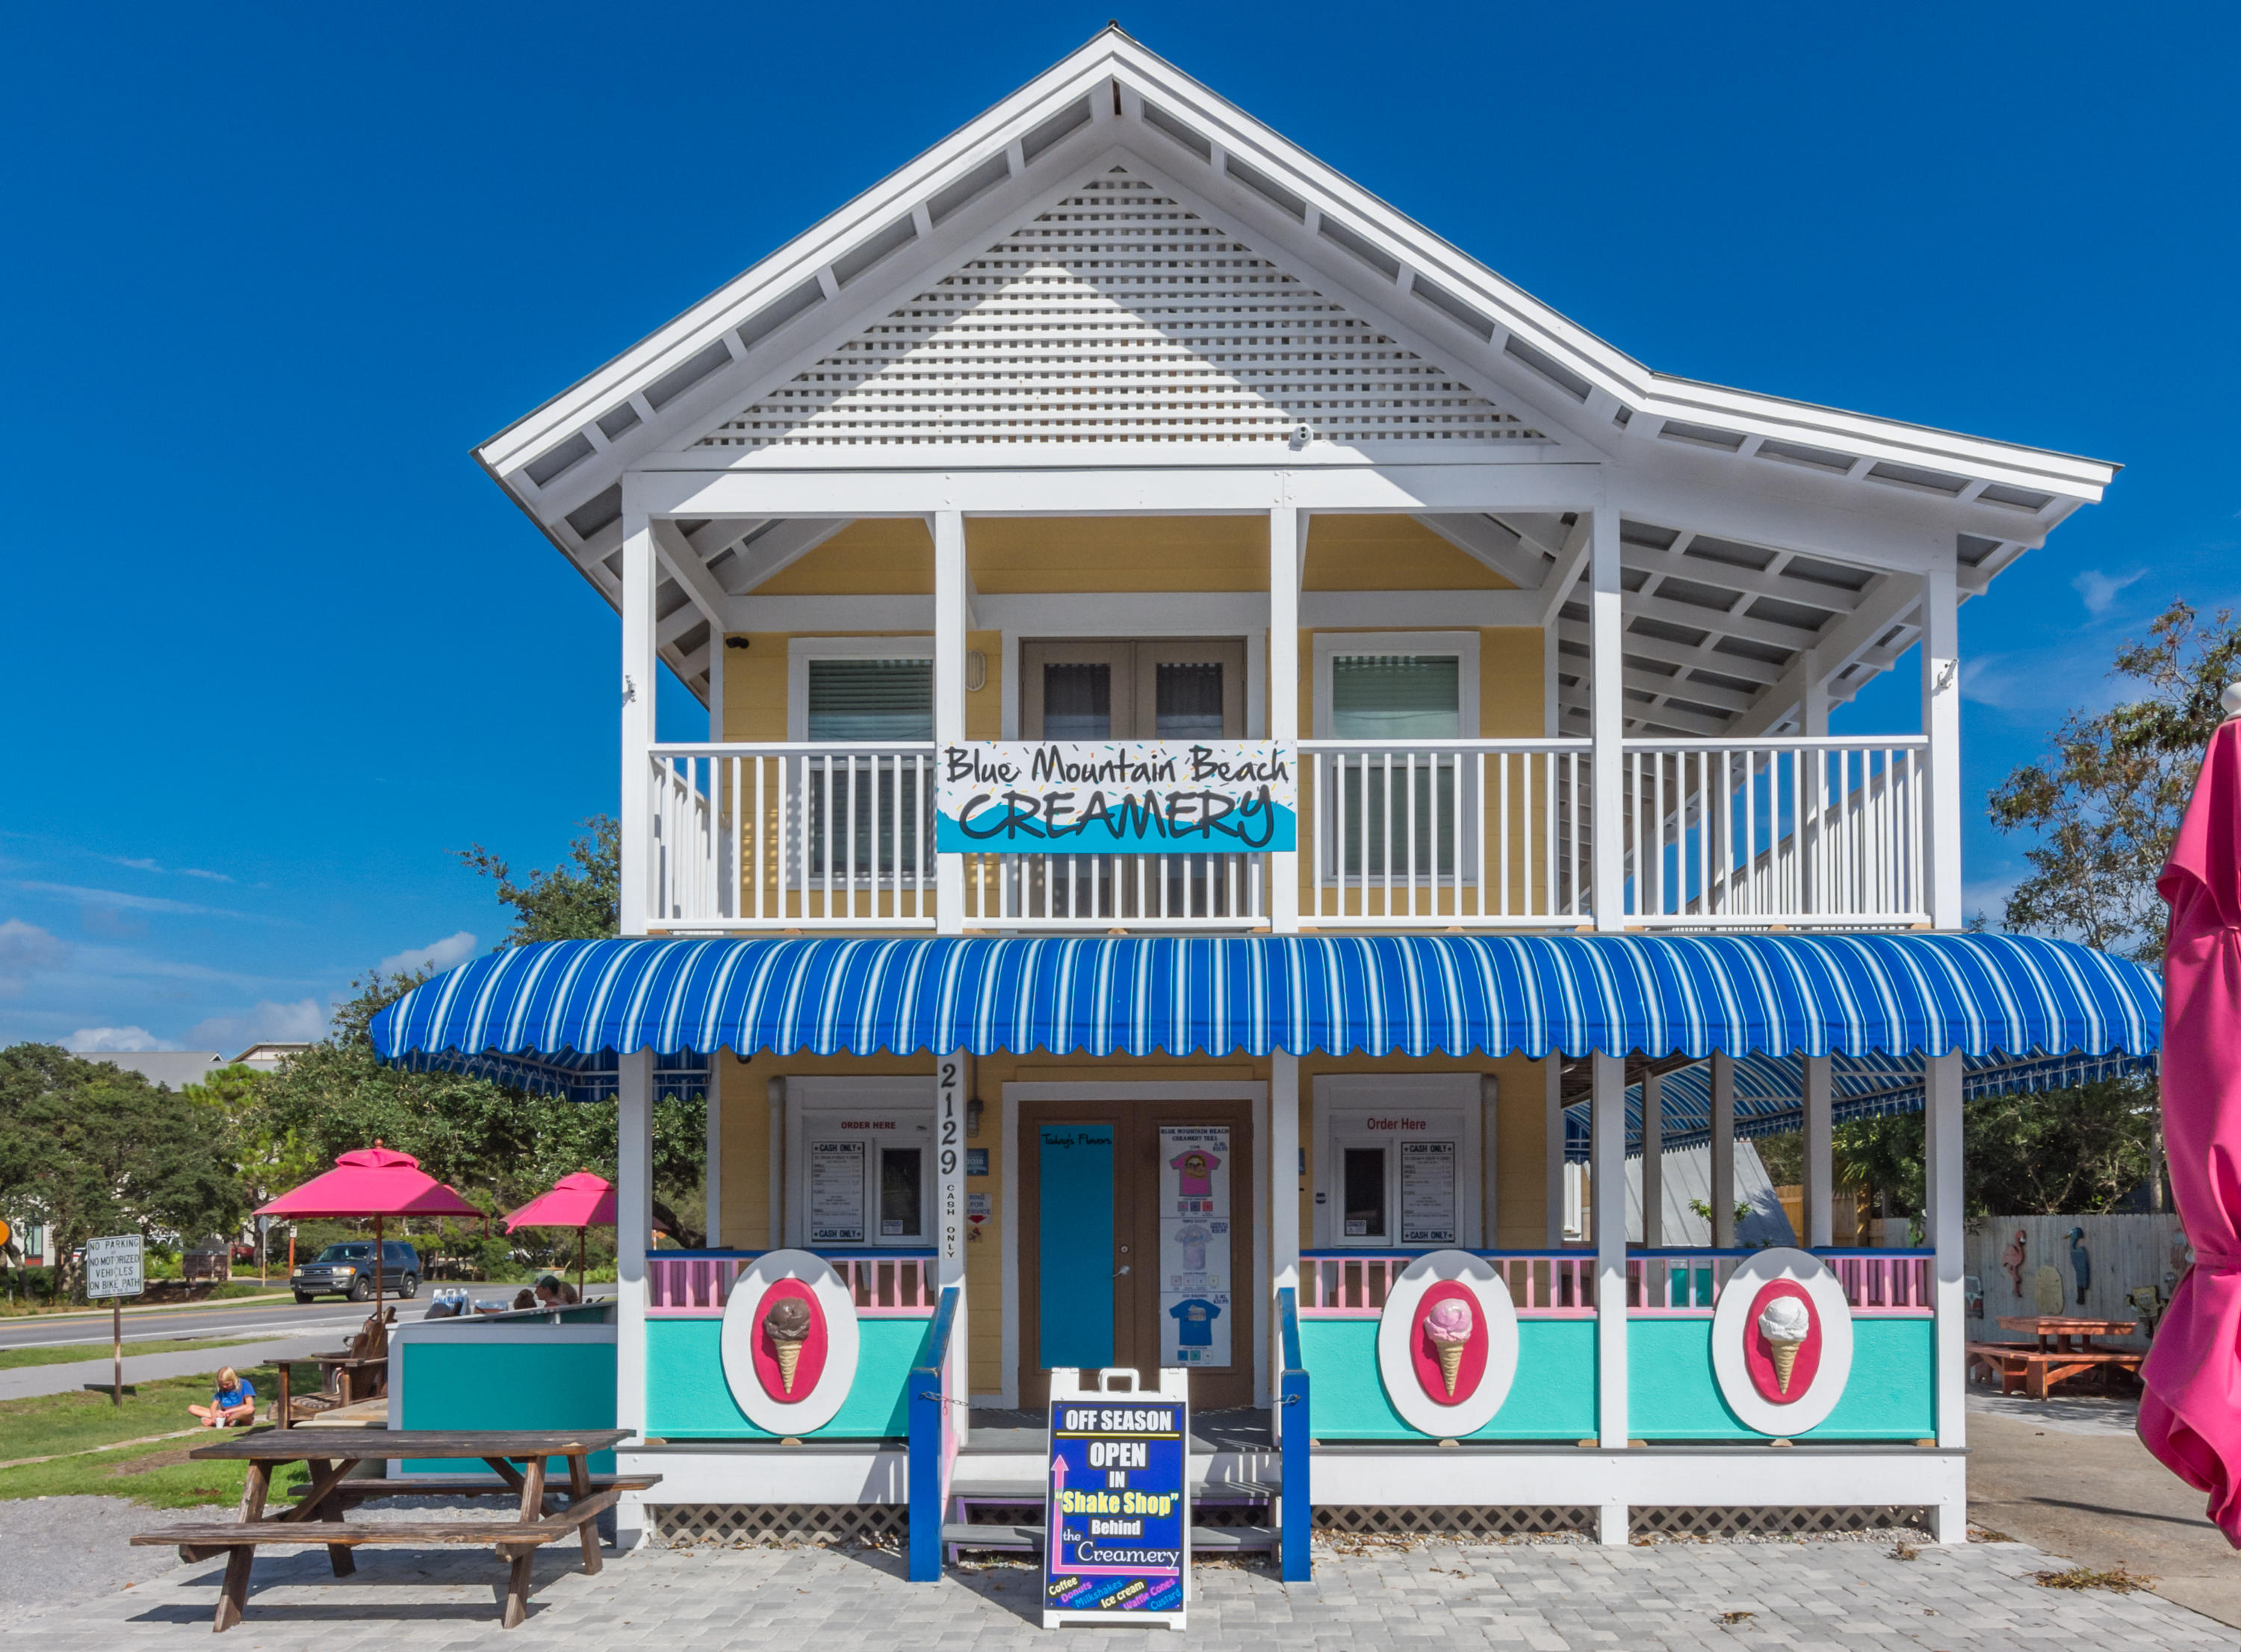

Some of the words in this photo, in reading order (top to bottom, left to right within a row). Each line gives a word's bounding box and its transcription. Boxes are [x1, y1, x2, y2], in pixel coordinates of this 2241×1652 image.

[946, 746, 1019, 782] Blue
[1032, 745, 1176, 783] Mountain
[1188, 747, 1289, 783] Beach
[959, 783, 1274, 848] CREAMERY
[940, 1063, 957, 1175] 2129
[1367, 1117, 1398, 1130] Order
[1401, 1117, 1426, 1130] Here
[819, 1143, 837, 1152] CASH
[840, 1143, 857, 1152] ONLY
[1041, 1133, 1076, 1149] Today's
[1078, 1133, 1112, 1145] Flavors
[1410, 1144, 1428, 1152] CASH
[1430, 1144, 1448, 1152] ONLY
[946, 1184, 955, 1216] CASH
[819, 1229, 837, 1238] CASH
[839, 1229, 857, 1238] ONLY
[946, 1226, 955, 1258] ONLY
[1410, 1231, 1428, 1240] CASH
[1431, 1231, 1448, 1240] ONLY
[90, 1241, 100, 1251] NO
[105, 1238, 139, 1249] PARKING
[90, 1258, 99, 1267] NO
[100, 1254, 140, 1266] MOTORIZED
[96, 1266, 133, 1278] VEHICLES
[90, 1281, 99, 1291] ON
[102, 1280, 119, 1290] BIKE
[122, 1278, 140, 1288] PATH
[1065, 1409, 1097, 1430] OFF
[1101, 1410, 1171, 1431] SEASON
[1089, 1442, 1146, 1467] OPEN
[1109, 1471, 1125, 1488] IN
[1063, 1529, 1081, 1541] the
[1091, 1519, 1141, 1535] Behind
[1078, 1541, 1180, 1570] Creamery
[1049, 1577, 1078, 1595] Coffee
[1061, 1581, 1093, 1603] Donuts
[1075, 1580, 1123, 1608] Milkshakes
[1100, 1596, 1117, 1609] Ice
[1117, 1581, 1144, 1600] cream
[1123, 1592, 1150, 1610] Waffle
[1150, 1577, 1176, 1596] Cones
[1150, 1589, 1182, 1610] Custard
